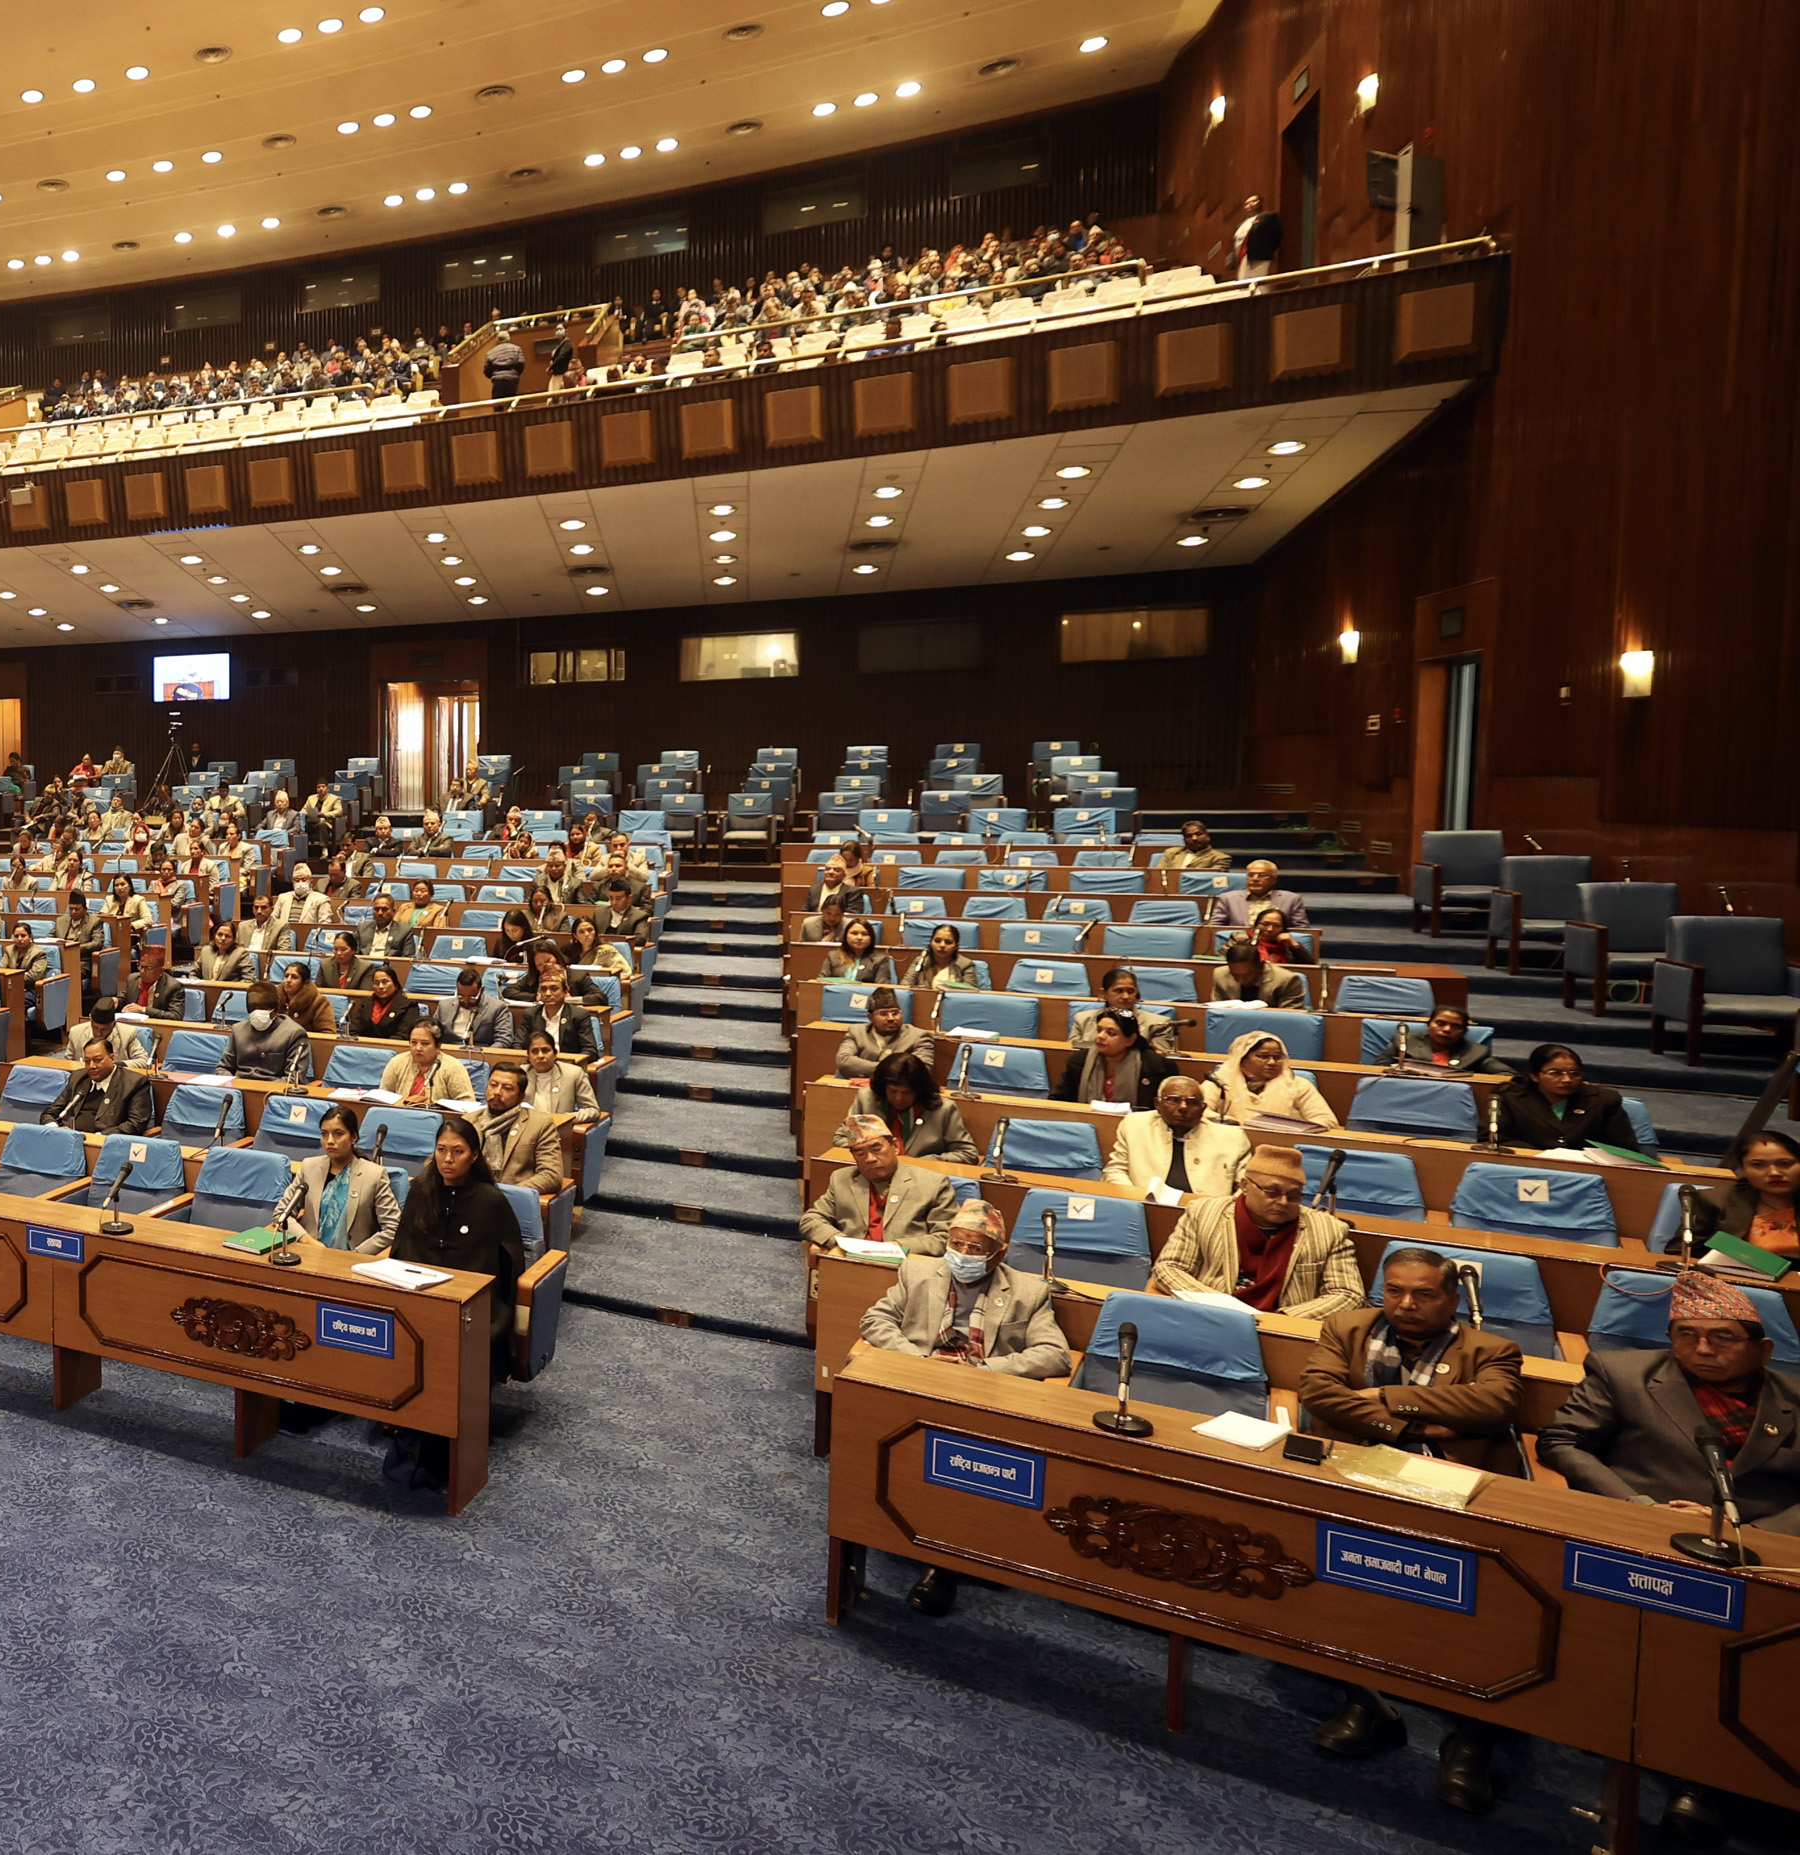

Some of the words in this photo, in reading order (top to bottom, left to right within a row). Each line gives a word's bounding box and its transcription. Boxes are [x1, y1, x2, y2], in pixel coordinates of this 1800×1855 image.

[1001, 1467, 1017, 1481] पार्टी
[1339, 1549, 1363, 1565] जनता
[1363, 1555, 1402, 1574] समाजवादी
[1423, 1566, 1448, 1585] नेपाल
[1627, 1571, 1675, 1597] सत्तापक्ष
